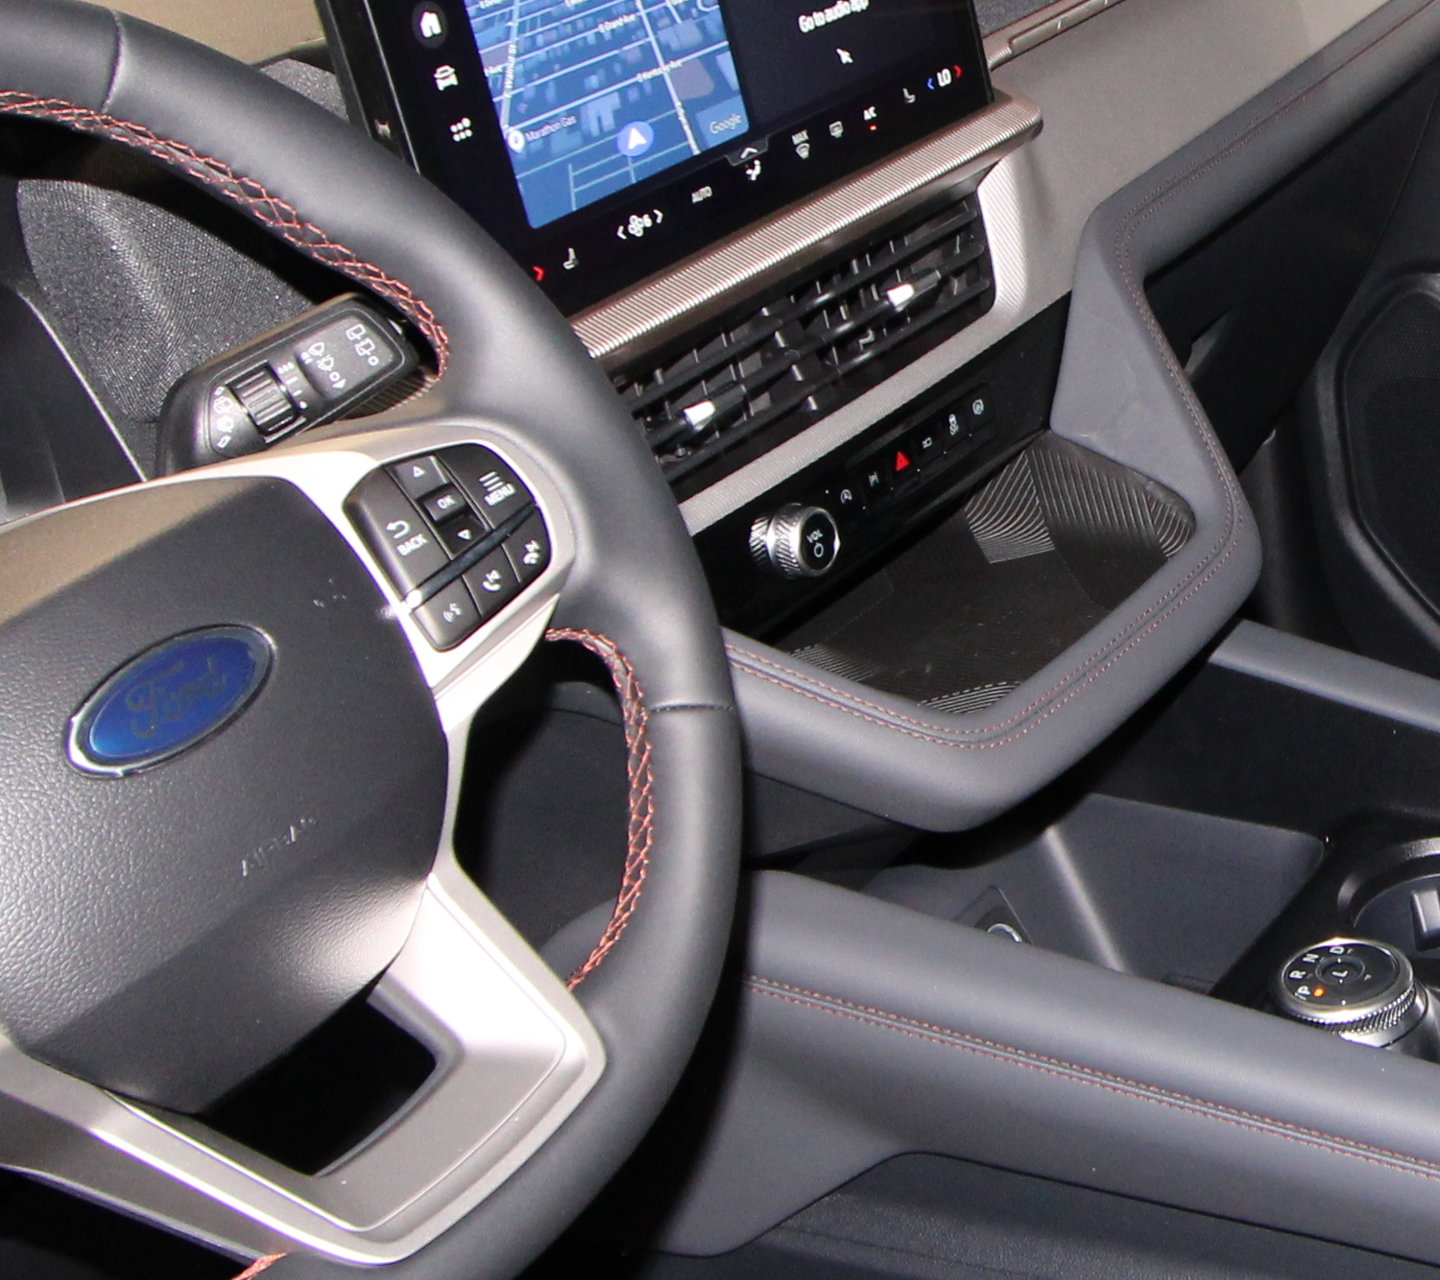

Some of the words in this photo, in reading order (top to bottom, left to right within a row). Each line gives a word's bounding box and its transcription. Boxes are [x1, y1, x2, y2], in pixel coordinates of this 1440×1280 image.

[798, 14, 815, 34] Go
[813, 9, 827, 28] to
[825, 0, 852, 23] audio
[936, 68, 952, 87] LO
[709, 113, 742, 136] Google
[691, 186, 713, 204] AUTO
[437, 494, 456, 509] OK
[484, 483, 517, 507] MENU
[397, 533, 428, 556] BACK
[806, 528, 824, 544] VOL
[124, 652, 228, 740] Ford
[1302, 953, 1319, 963] N
[1329, 945, 1345, 955] D
[1289, 969, 1306, 979] R
[1297, 985, 1311, 996] P
